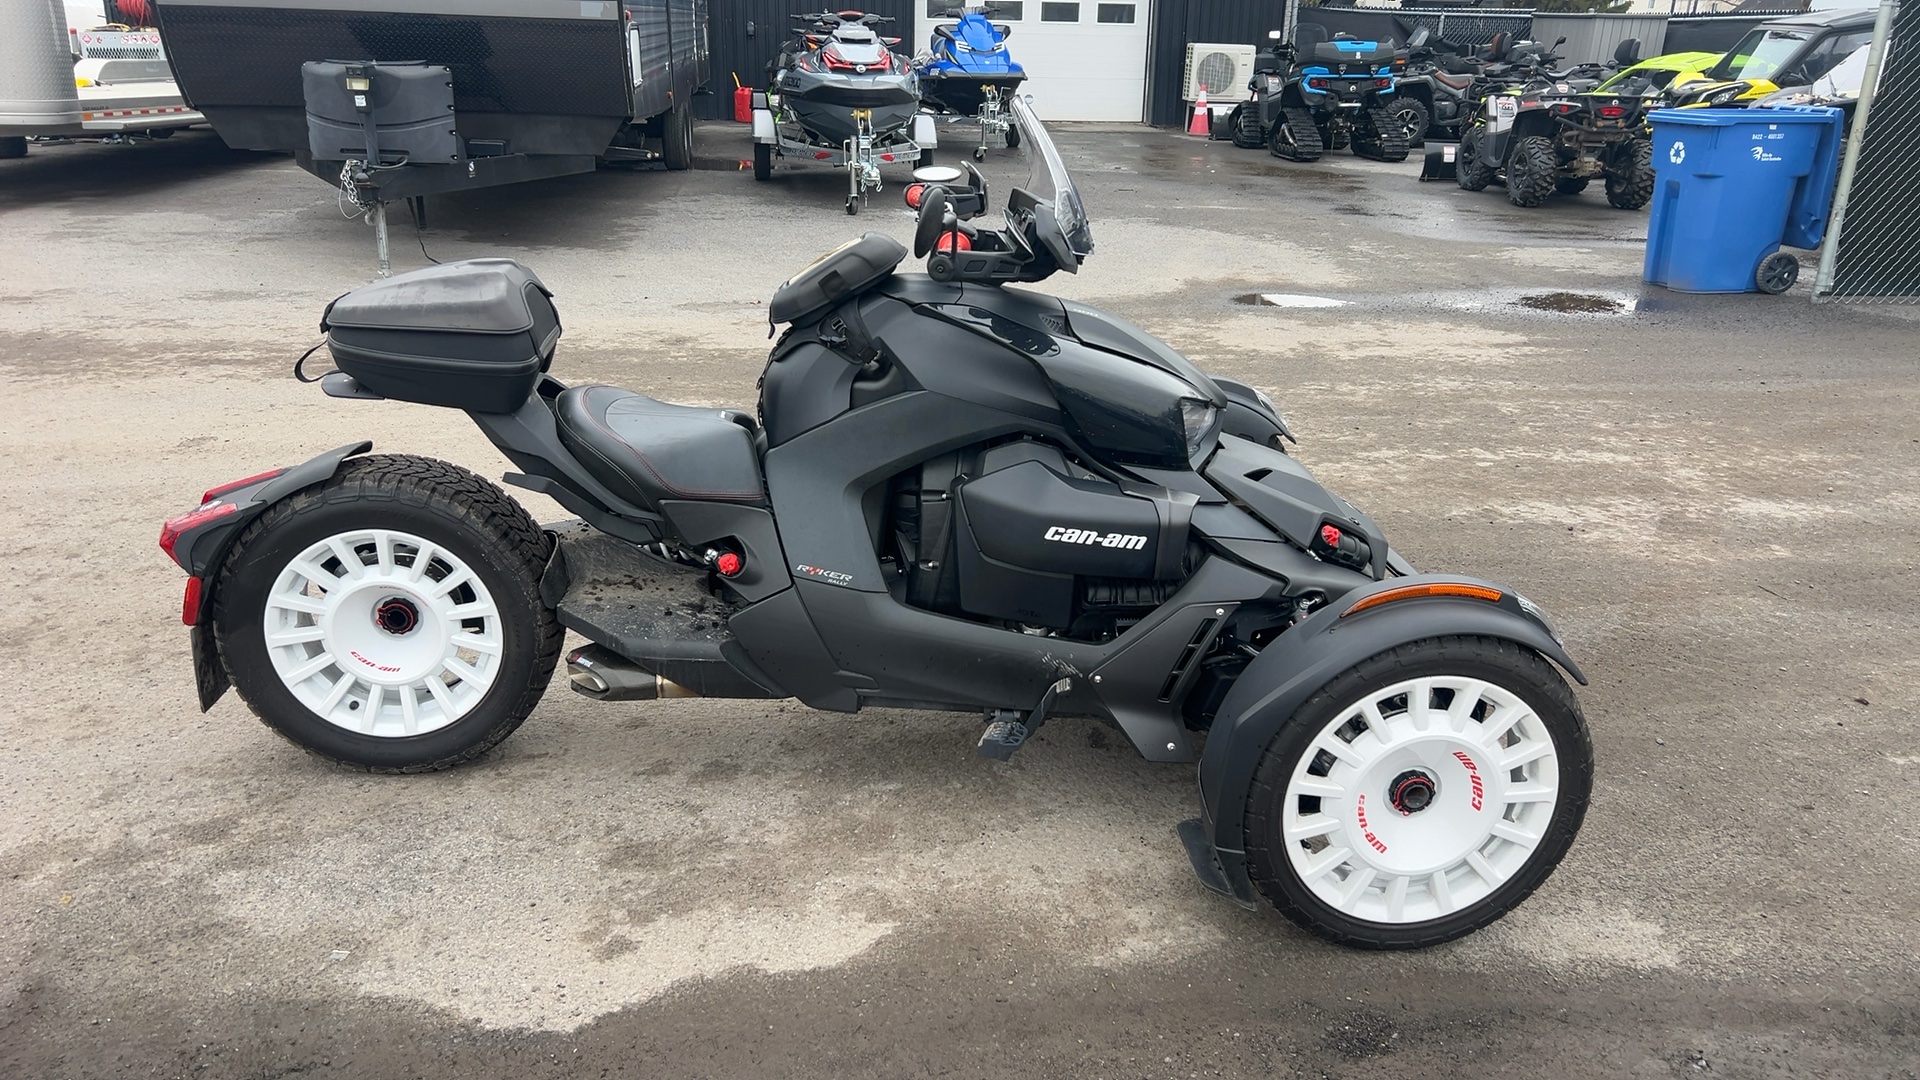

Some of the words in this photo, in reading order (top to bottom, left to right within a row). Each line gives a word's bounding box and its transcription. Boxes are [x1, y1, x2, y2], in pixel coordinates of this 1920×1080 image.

[1044, 526, 1148, 550] can-am
[796, 564, 853, 581] RYKER
[827, 578, 848, 586] RALLY
[351, 651, 401, 672] can-am
[1452, 751, 1483, 811] can-am
[1357, 794, 1388, 854] can-am
